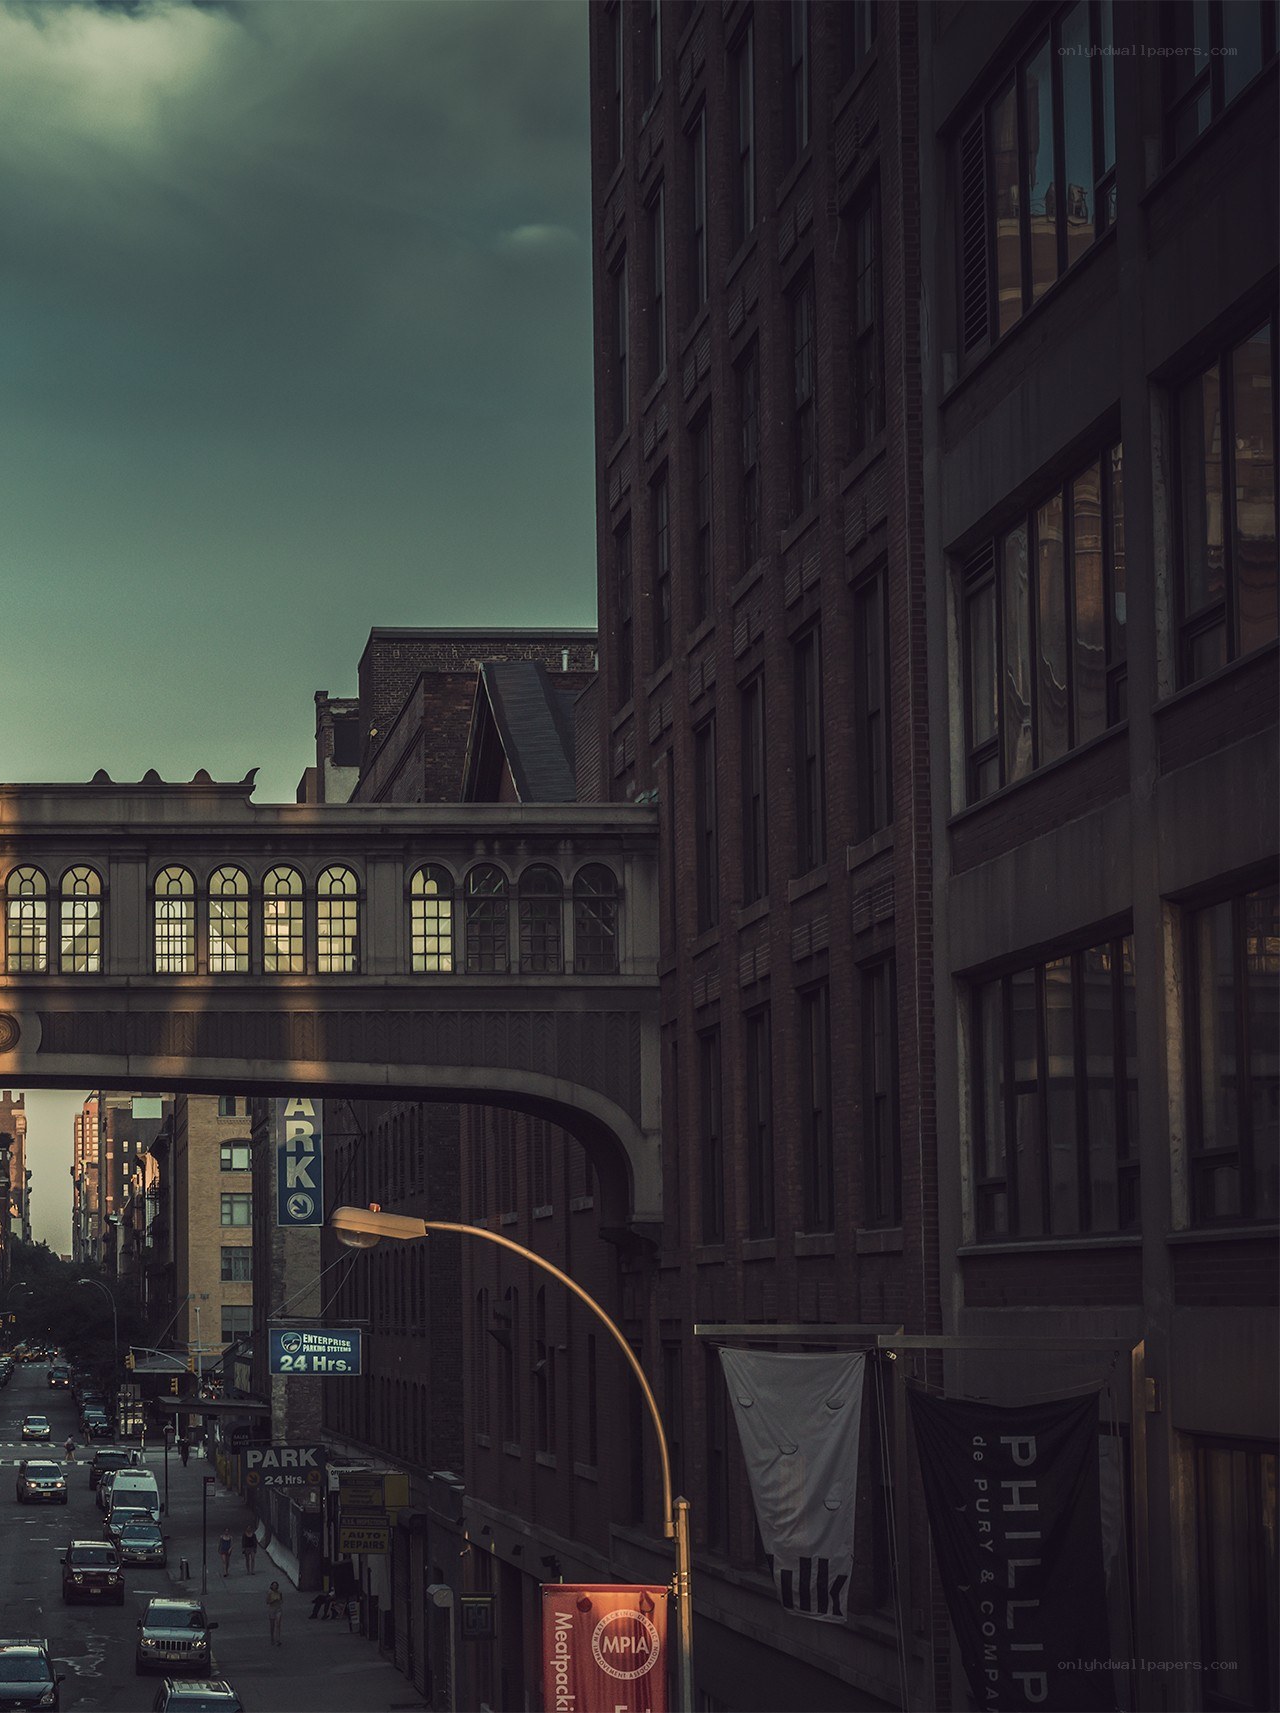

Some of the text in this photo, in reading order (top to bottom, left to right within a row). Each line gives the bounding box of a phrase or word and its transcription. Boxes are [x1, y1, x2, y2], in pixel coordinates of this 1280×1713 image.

[302, 1333, 352, 1347] ENTERPRISE
[302, 1344, 352, 1353] PARKING SYSTEMS
[280, 1354, 352, 1372] 24 Hrs.
[972, 1435, 987, 1462] de
[246, 1447, 318, 1469] PARK
[264, 1475, 306, 1486] 24 Hrs.
[974, 1478, 994, 1553] PURY
[348, 1532, 381, 1540] AUTO
[343, 1540, 385, 1550] REPAIRS
[979, 1568, 995, 1584] &
[602, 1635, 650, 1654] MPIA
[592, 1645, 659, 1679] IMPROVEMENT ASSOCIATION
